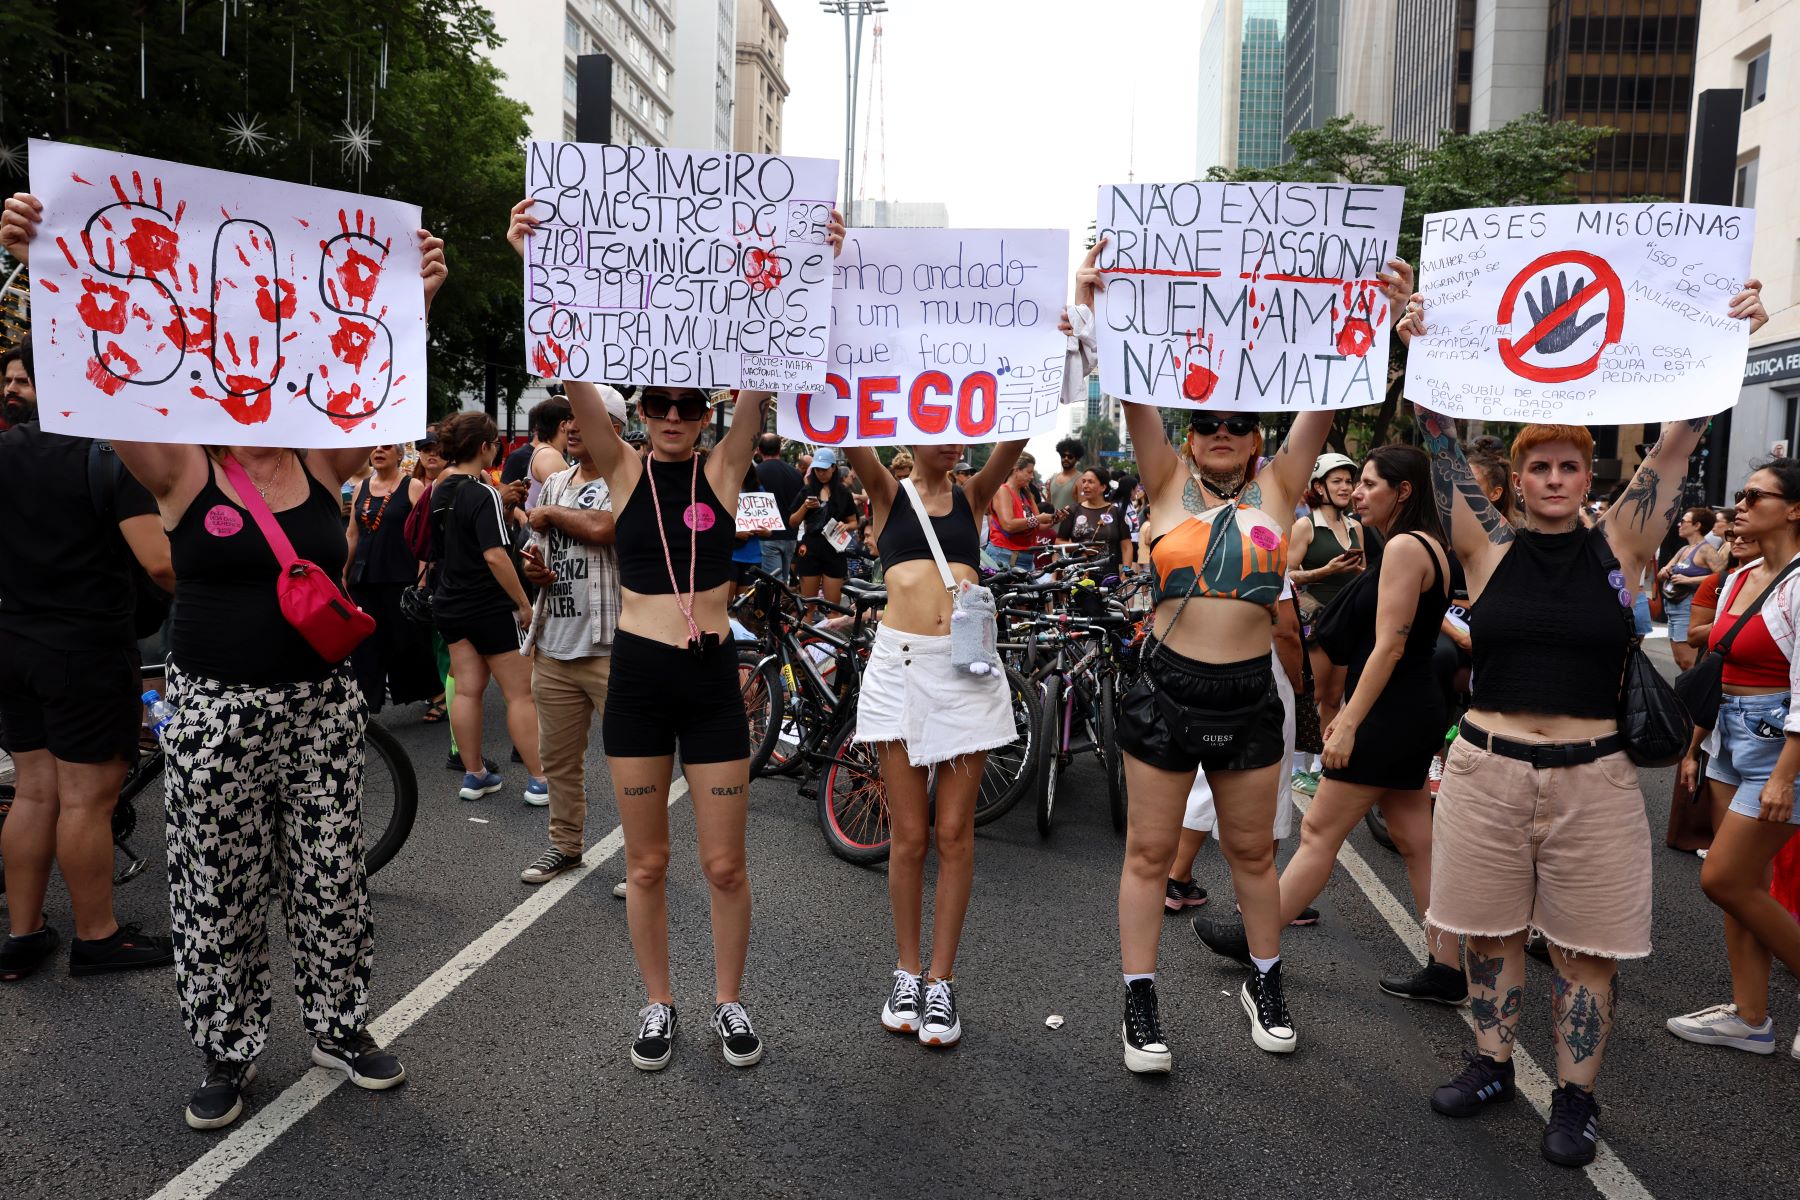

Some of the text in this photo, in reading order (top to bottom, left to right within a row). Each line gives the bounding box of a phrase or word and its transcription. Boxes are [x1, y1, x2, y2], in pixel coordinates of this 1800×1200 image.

[530, 142, 586, 188] NO
[1111, 183, 1201, 226] NÃO
[1424, 211, 1547, 246] FRASES
[538, 227, 580, 266] 718
[833, 239, 1038, 295] enho andado
[1423, 268, 1480, 292] NGRAViDA
[1703, 273, 1749, 296] COiS
[528, 305, 651, 346] CONTRA
[857, 304, 899, 328] um
[920, 288, 1039, 327] mundo
[1106, 278, 1376, 347] QUEM AMA
[1480, 324, 1513, 336] MAL
[537, 341, 589, 378] NO
[785, 360, 813, 371] MAPA
[835, 333, 986, 381] que ficou
[1123, 338, 1375, 406] NÃO MATA
[1598, 357, 1646, 370] ROUPA
[1744, 353, 1800, 377] JUSTIÇA FE
[998, 365, 1036, 434] Billie
[1033, 354, 1065, 418] Eilish
[1541, 389, 1597, 401] CARGO?
[796, 370, 998, 445] CEGO
[1519, 399, 1564, 410] DADO
[737, 495, 777, 511] ROTEJAM
[744, 508, 769, 518] SUAS
[736, 517, 784, 529] AMIGAS
[548, 581, 573, 597] ENDE
[1202, 734, 1234, 743] GUESS
